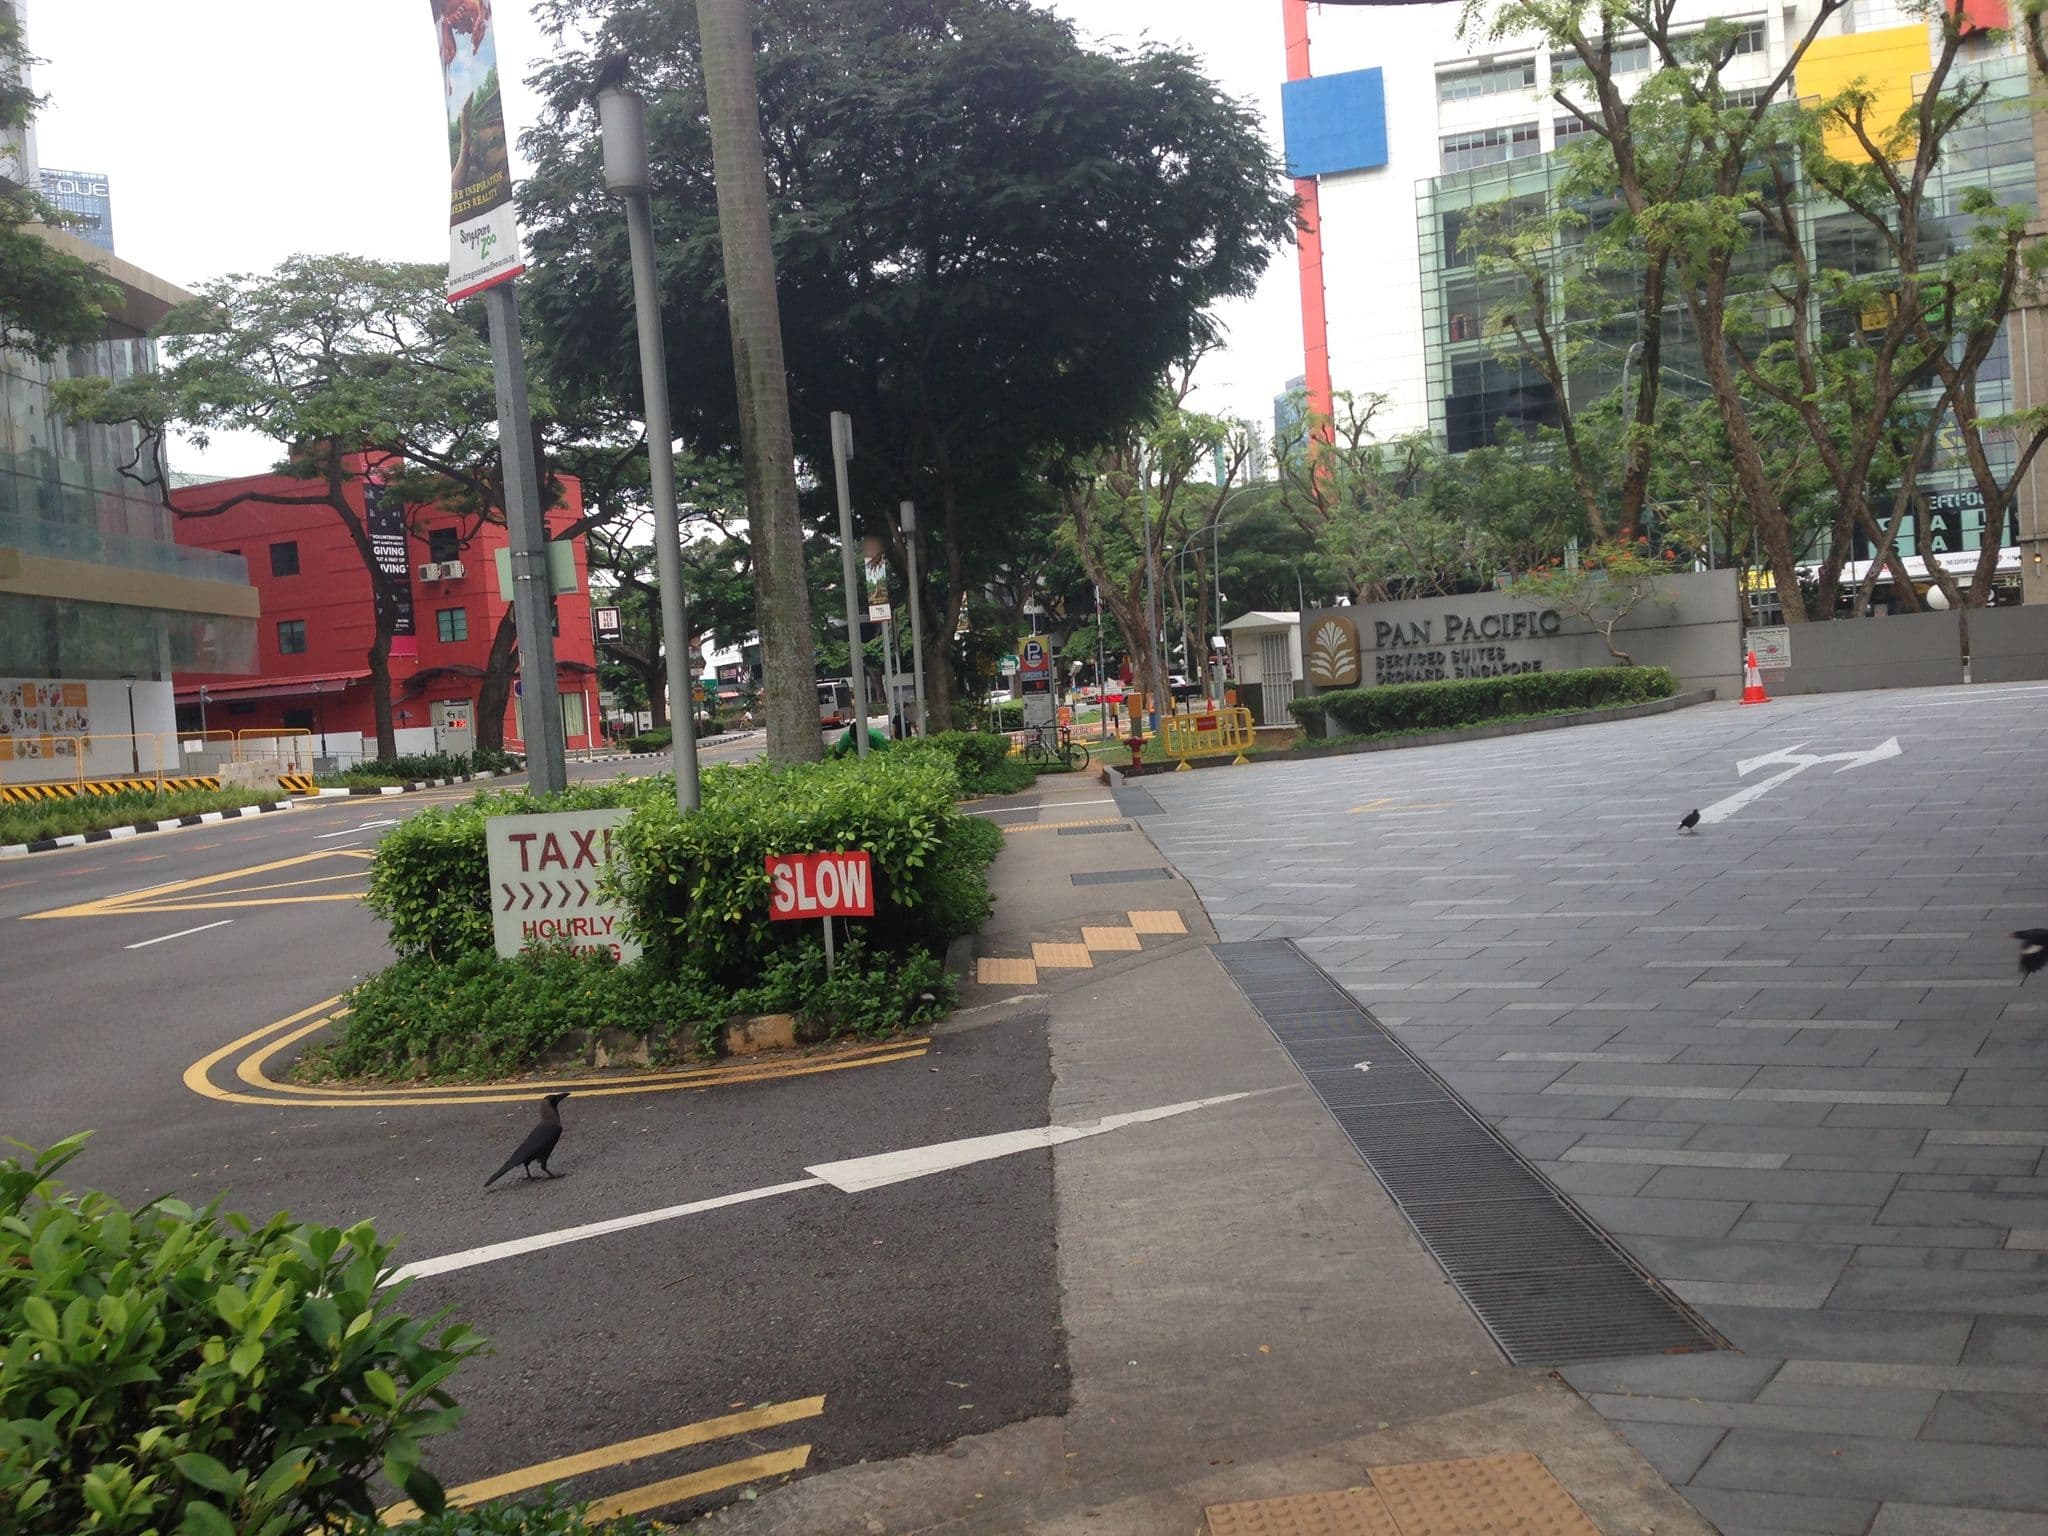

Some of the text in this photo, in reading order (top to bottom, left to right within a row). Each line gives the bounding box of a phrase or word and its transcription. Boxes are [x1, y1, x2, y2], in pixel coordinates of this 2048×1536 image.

[58, 179, 109, 197] OUE
[472, 188, 498, 206] REALITY
[460, 223, 491, 250] Singapore
[373, 546, 405, 556] GIVING
[1374, 609, 1562, 648] PAN PACIFIC
[1375, 645, 1506, 670] SERVICED SUITES
[1454, 659, 1543, 680] SINGAPORE
[772, 858, 868, 913] SLOW
[522, 915, 616, 939] HOURLY
